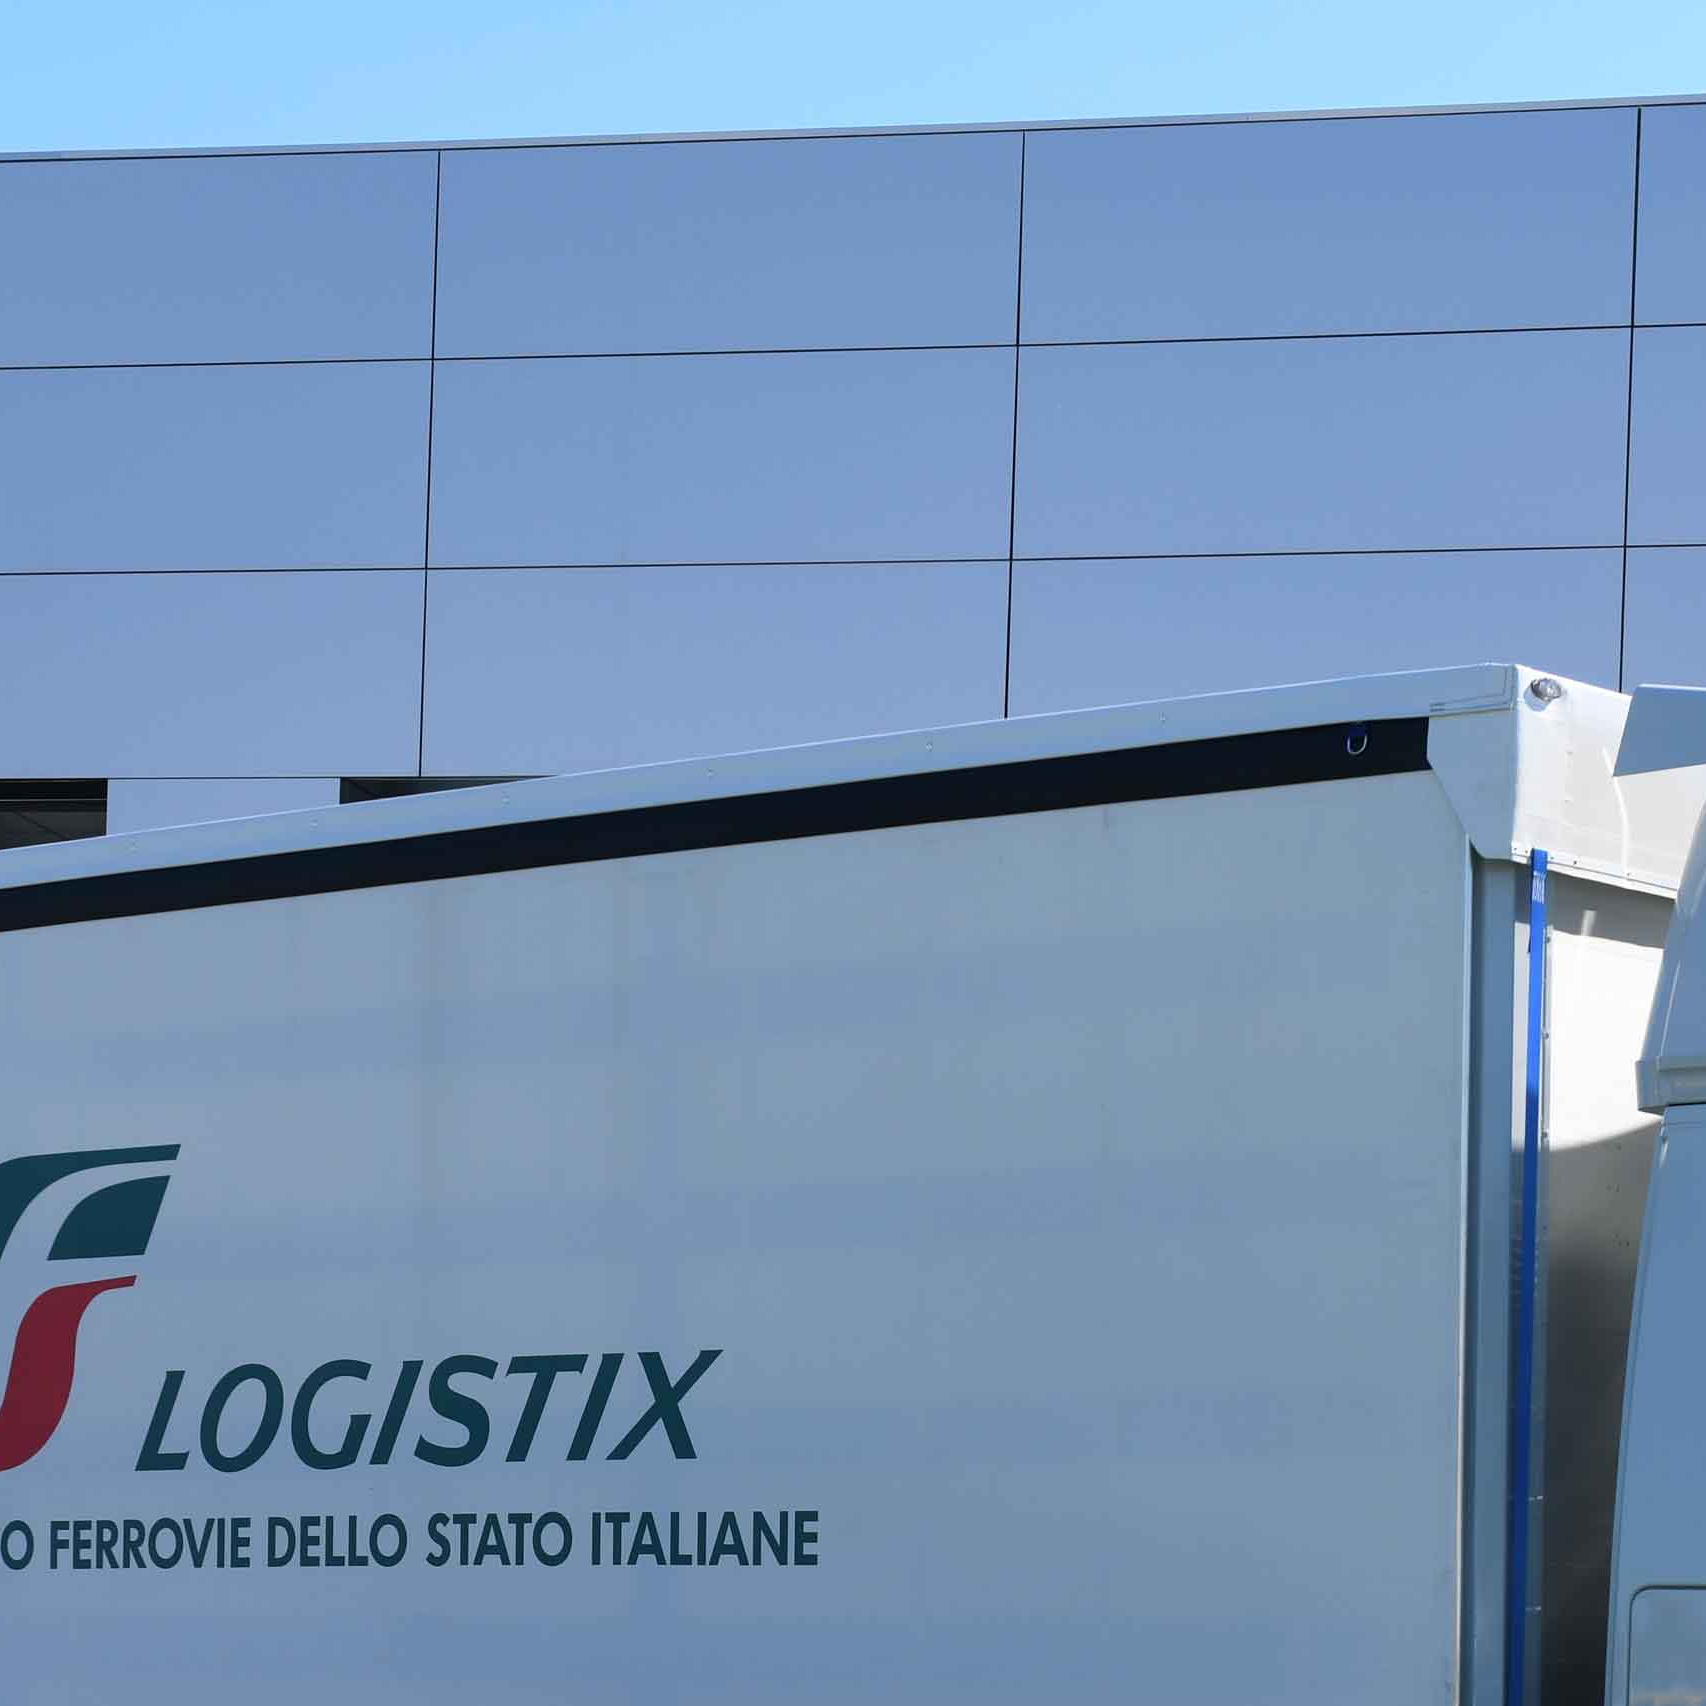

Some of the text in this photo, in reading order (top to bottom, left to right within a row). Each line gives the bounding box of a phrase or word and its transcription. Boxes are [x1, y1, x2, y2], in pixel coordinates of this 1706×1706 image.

[133, 1349, 724, 1473] LOGISTIX
[49, 1516, 252, 1570] FERROVIE
[267, 1513, 408, 1568] DELLO
[425, 1511, 573, 1567] STATO
[591, 1510, 820, 1566] ITALIANE
